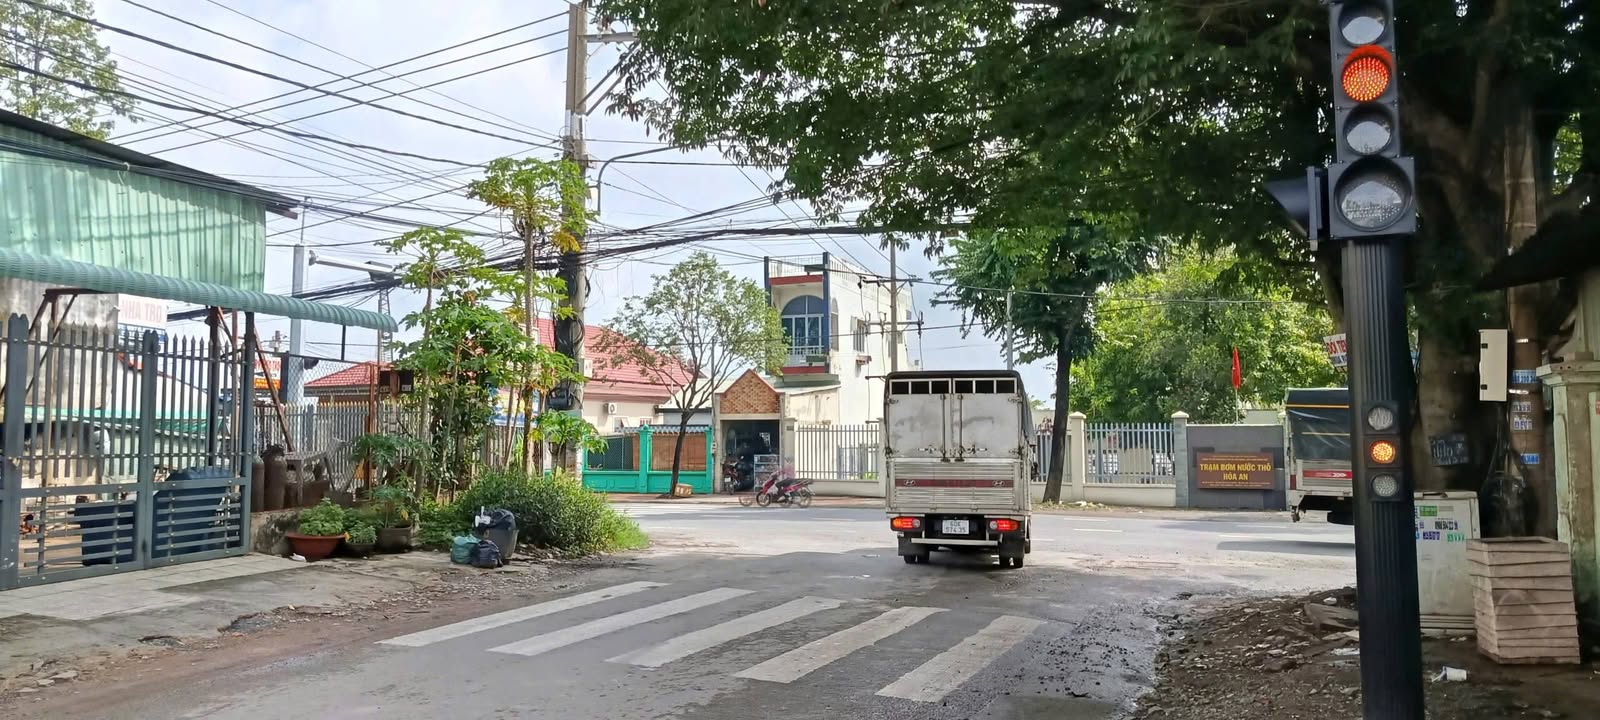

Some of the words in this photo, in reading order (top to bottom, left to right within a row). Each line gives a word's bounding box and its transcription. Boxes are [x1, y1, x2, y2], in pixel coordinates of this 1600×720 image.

[1200, 463, 1219, 472] TRẠM
[1220, 463, 1236, 471] BƠM
[1237, 462, 1256, 471] NƯỚC
